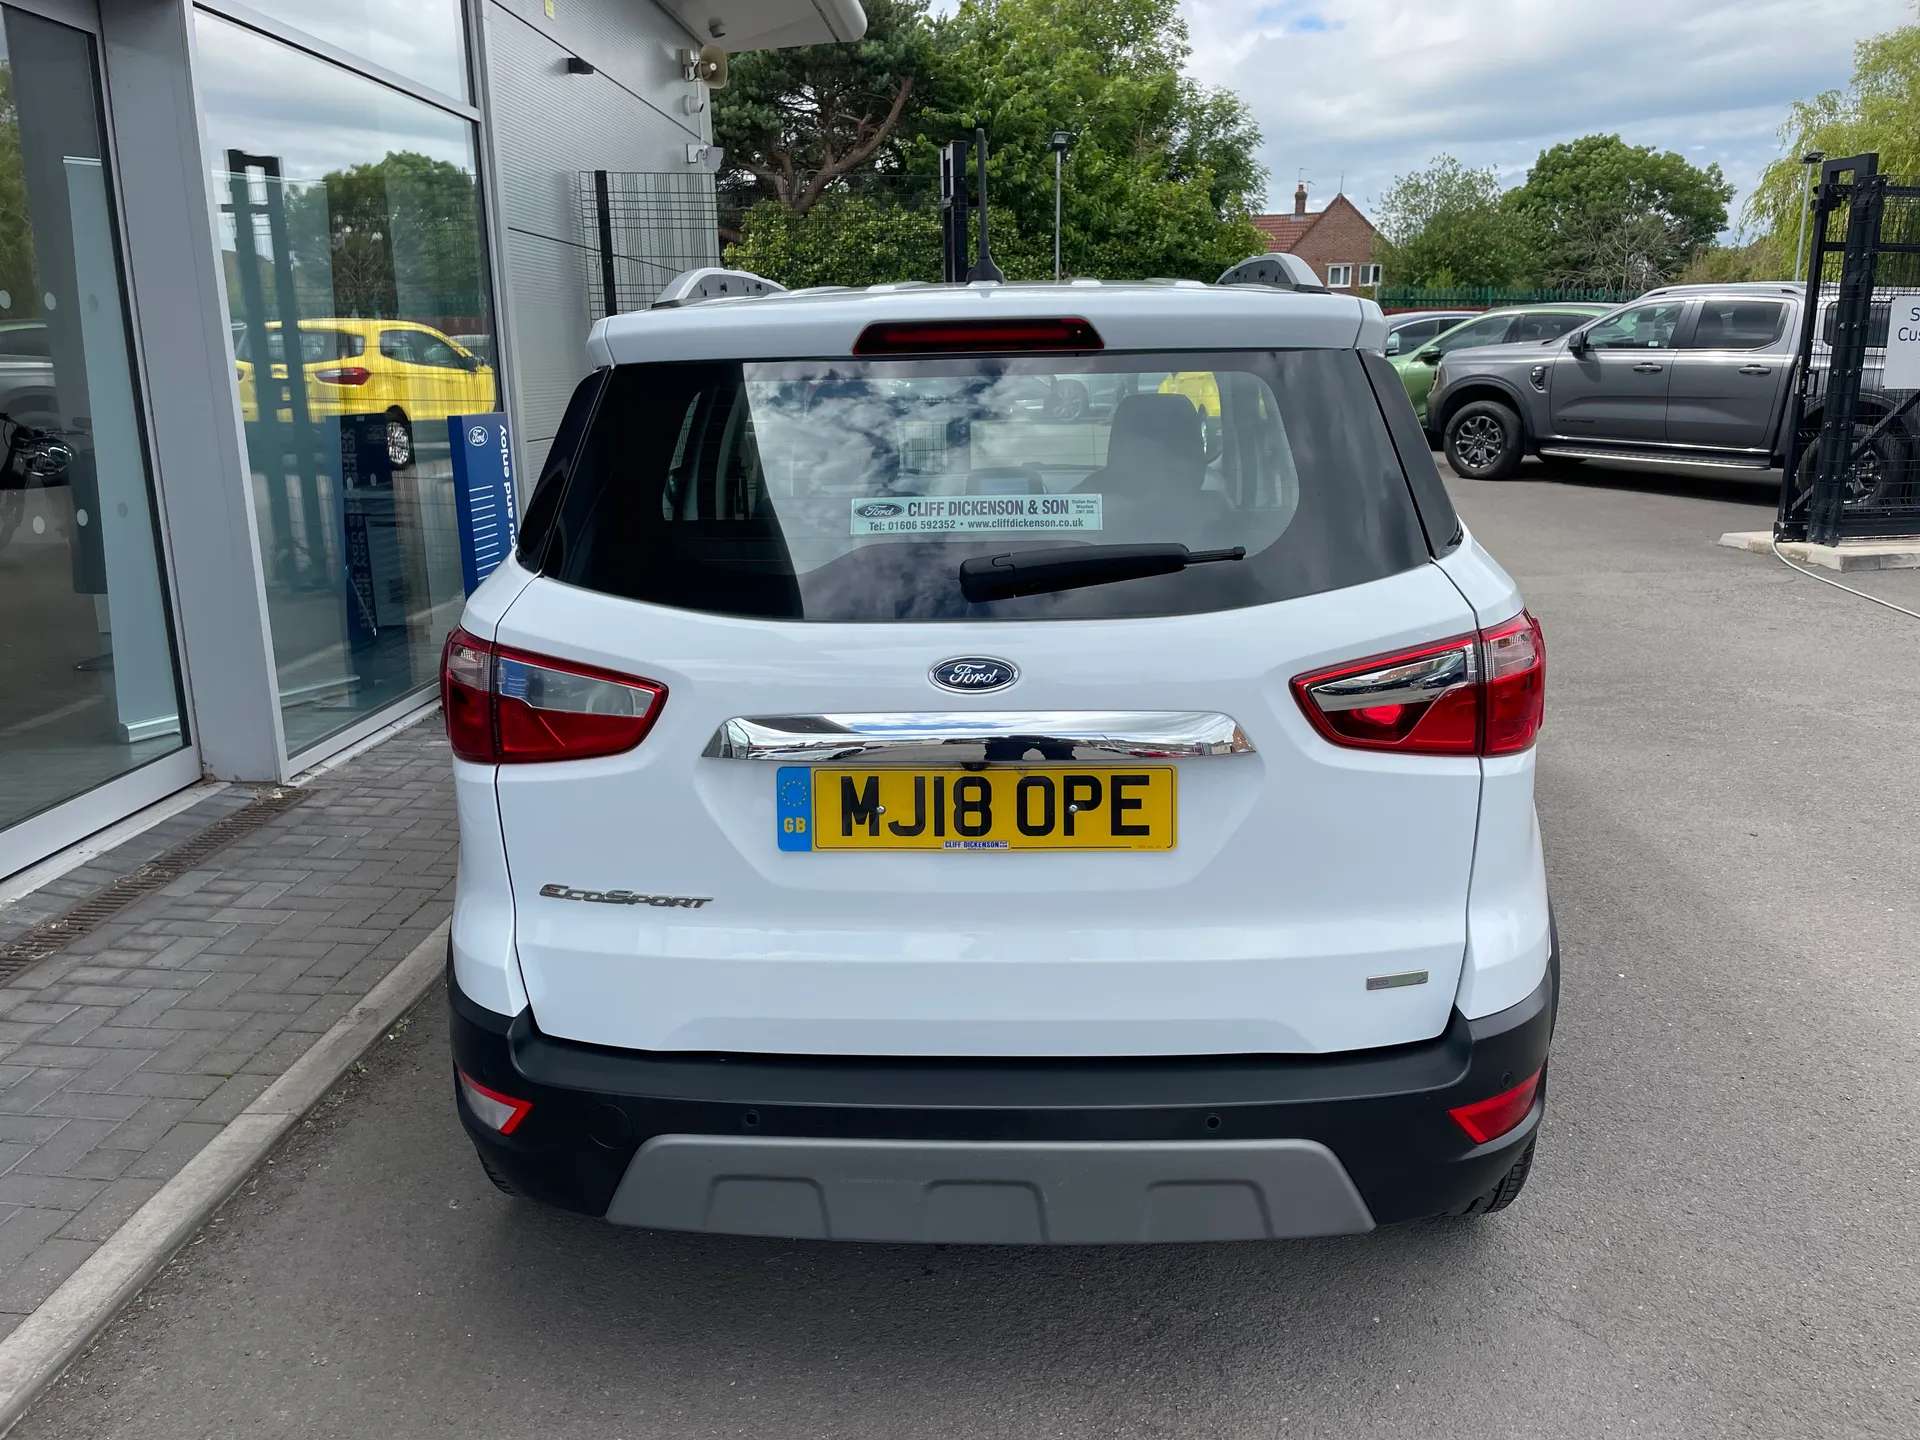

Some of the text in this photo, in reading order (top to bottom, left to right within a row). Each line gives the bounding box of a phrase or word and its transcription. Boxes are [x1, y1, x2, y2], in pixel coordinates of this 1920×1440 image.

[499, 424, 510, 479] enjoy
[504, 482, 514, 519] and
[907, 502, 945, 517] CLIFF
[948, 500, 1024, 517] DICKENSON
[1028, 500, 1040, 515] &
[1042, 499, 1069, 515] SON
[869, 517, 1084, 531] Tel: 01606 592352 www.cliffdickenson.co.uk
[840, 775, 1151, 838] MJ18 OPE
[783, 816, 806, 833] GB
